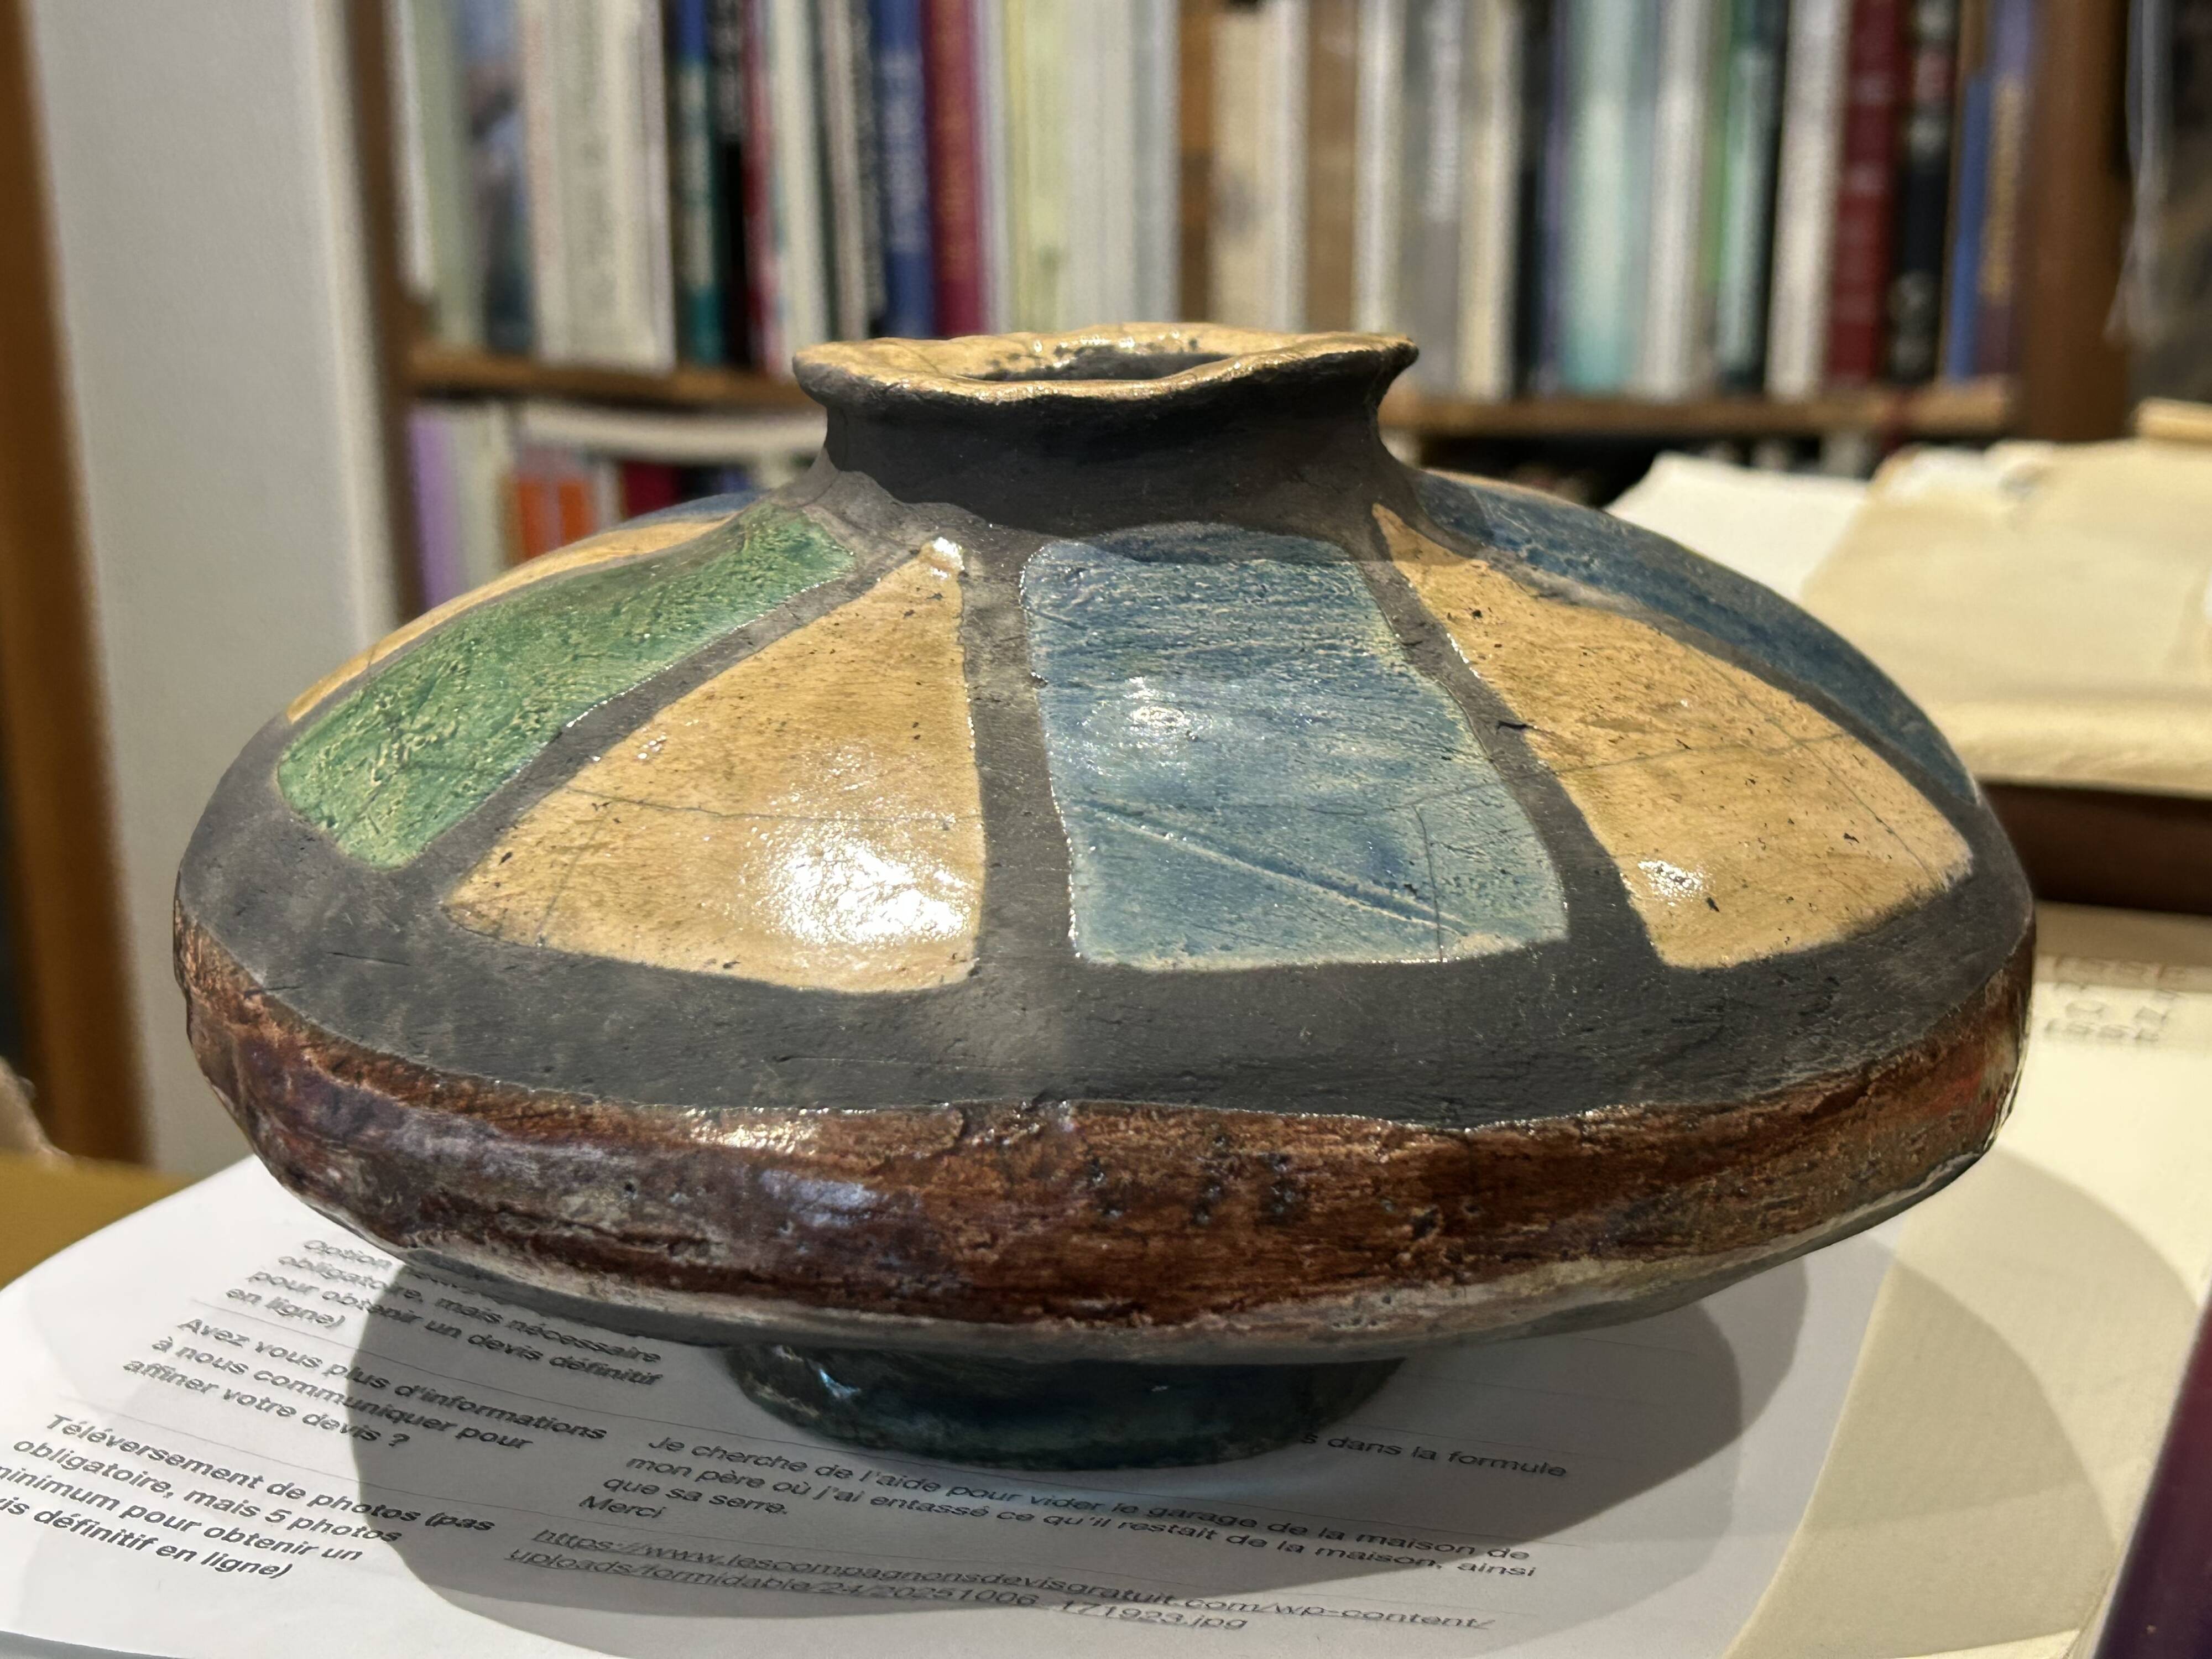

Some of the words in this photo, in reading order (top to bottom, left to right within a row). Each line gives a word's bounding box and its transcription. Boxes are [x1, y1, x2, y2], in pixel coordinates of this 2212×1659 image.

[226, 1288, 263, 1306] en
[265, 1296, 346, 1329] ligne)
[246, 1271, 320, 1295] pour
[424, 1321, 462, 1339] un
[467, 1334, 543, 1361] devis
[435, 1297, 503, 1324] mais
[122, 1360, 219, 1394] affiner
[223, 1388, 298, 1417] votre
[302, 1413, 382, 1442] devis
[388, 1433, 411, 1448] ?
[152, 1336, 173, 1353] à
[175, 1346, 249, 1375] nous
[254, 1370, 457, 1431] communiquer
[456, 1427, 534, 1449] pour
[177, 1318, 250, 1348] Avez
[255, 1341, 324, 1369] vous
[321, 1364, 390, 1390] plus
[394, 1384, 607, 1439] d'informations
[14, 1440, 174, 1499] obligatoire,
[184, 1490, 261, 1517] mais
[265, 1509, 293, 1523] 5
[286, 1517, 403, 1542] photos
[47, 1414, 264, 1489] Téléversement
[265, 1482, 306, 1500] de
[306, 1493, 421, 1522] photos
[425, 1511, 495, 1531] (pas
[603, 1478, 660, 1495] que
[665, 1488, 703, 1503] sa
[709, 1494, 787, 1515] serre.
[648, 1437, 685, 1452] Je
[691, 1446, 808, 1473] cherche
[815, 1464, 853, 1480] de
[859, 1470, 941, 1493] l'aide
[946, 1486, 1022, 1503] pour
[1031, 1495, 1105, 1511] vider
[1112, 1502, 1140, 1514] le
[1149, 1507, 1258, 1528] garage
[1267, 1522, 1308, 1536] de
[1318, 1527, 1345, 1541] la
[1356, 1533, 1475, 1556] maison
[1487, 1548, 1530, 1561] de
[1328, 1436, 1402, 1456] dans
[1411, 1446, 1437, 1461] la
[1448, 1451, 1567, 1478] formule
[33, 1510, 159, 1551] définitif
[155, 1544, 198, 1562] en
[200, 1551, 293, 1579] ligne)
[118, 1505, 202, 1531] pour
[204, 1527, 319, 1556] obtenir
[321, 1547, 363, 1561] un
[578, 1495, 667, 1519] Merci
[626, 1457, 692, 1478] mon
[695, 1469, 765, 1489] père
[773, 1481, 811, 1496] où
[812, 1485, 865, 1503] j'ai
[870, 1495, 990, 1517] entassé
[997, 1511, 1035, 1522] ce
[1043, 1515, 1112, 1528] qu'il
[1117, 1520, 1218, 1541] restait
[1226, 1534, 1268, 1548] de
[1277, 1541, 1305, 1553] la
[1315, 1547, 1442, 1569] maison,
[1457, 1563, 1537, 1577] ainsi
